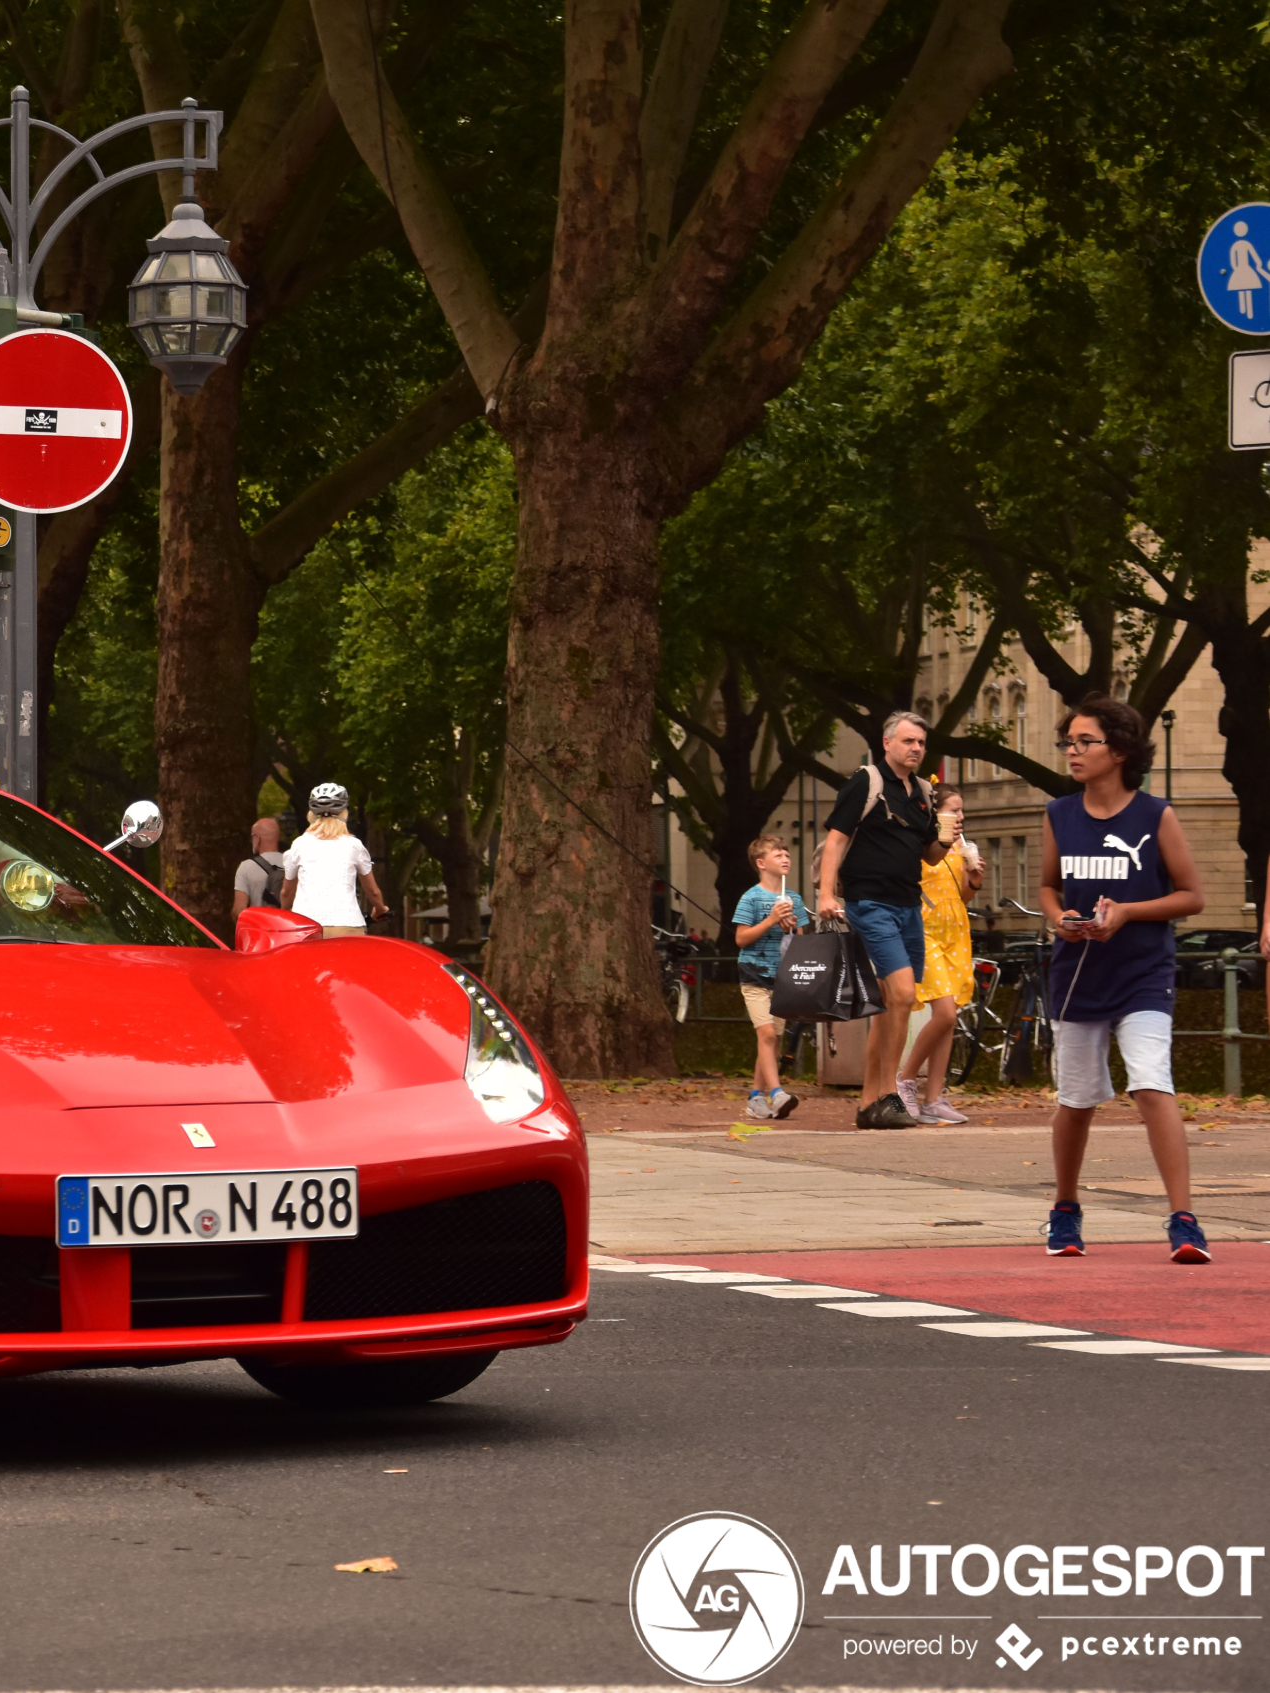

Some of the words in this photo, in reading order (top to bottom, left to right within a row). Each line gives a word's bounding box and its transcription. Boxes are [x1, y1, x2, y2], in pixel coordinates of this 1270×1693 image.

[1060, 856, 1129, 879] PUMA
[789, 964, 827, 972] Abercrombie
[799, 971, 815, 980] Fitch
[68, 1219, 81, 1234] D
[92, 1184, 192, 1235] NOR
[228, 1181, 258, 1232] N
[271, 1177, 353, 1231] 488
